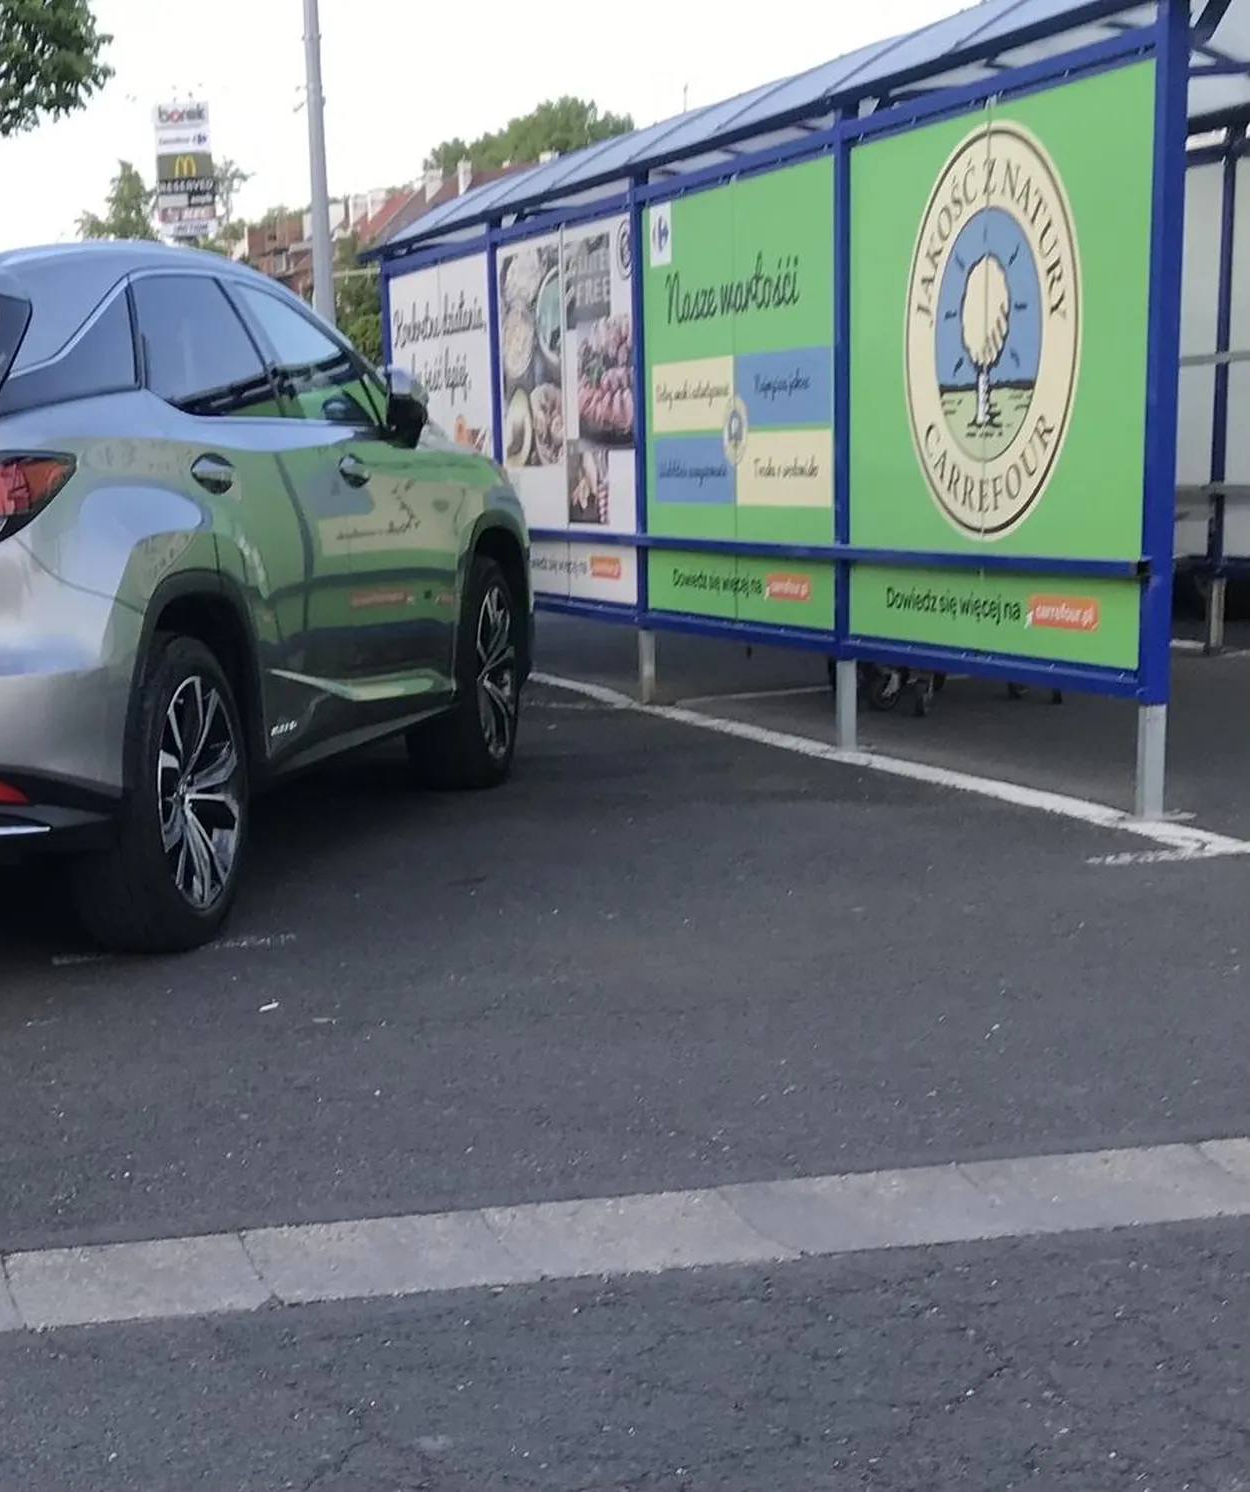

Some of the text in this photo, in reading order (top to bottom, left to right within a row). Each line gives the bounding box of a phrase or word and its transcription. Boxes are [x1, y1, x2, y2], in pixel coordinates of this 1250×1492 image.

[158, 103, 205, 123] borek
[916, 156, 1067, 328] JAKOŚĆ Z NATURY
[665, 250, 800, 326] Nasze wartości
[924, 413, 1056, 513] CARREFOUR
[886, 586, 1095, 626] Dowiedz się więcej na carrefour.pl
